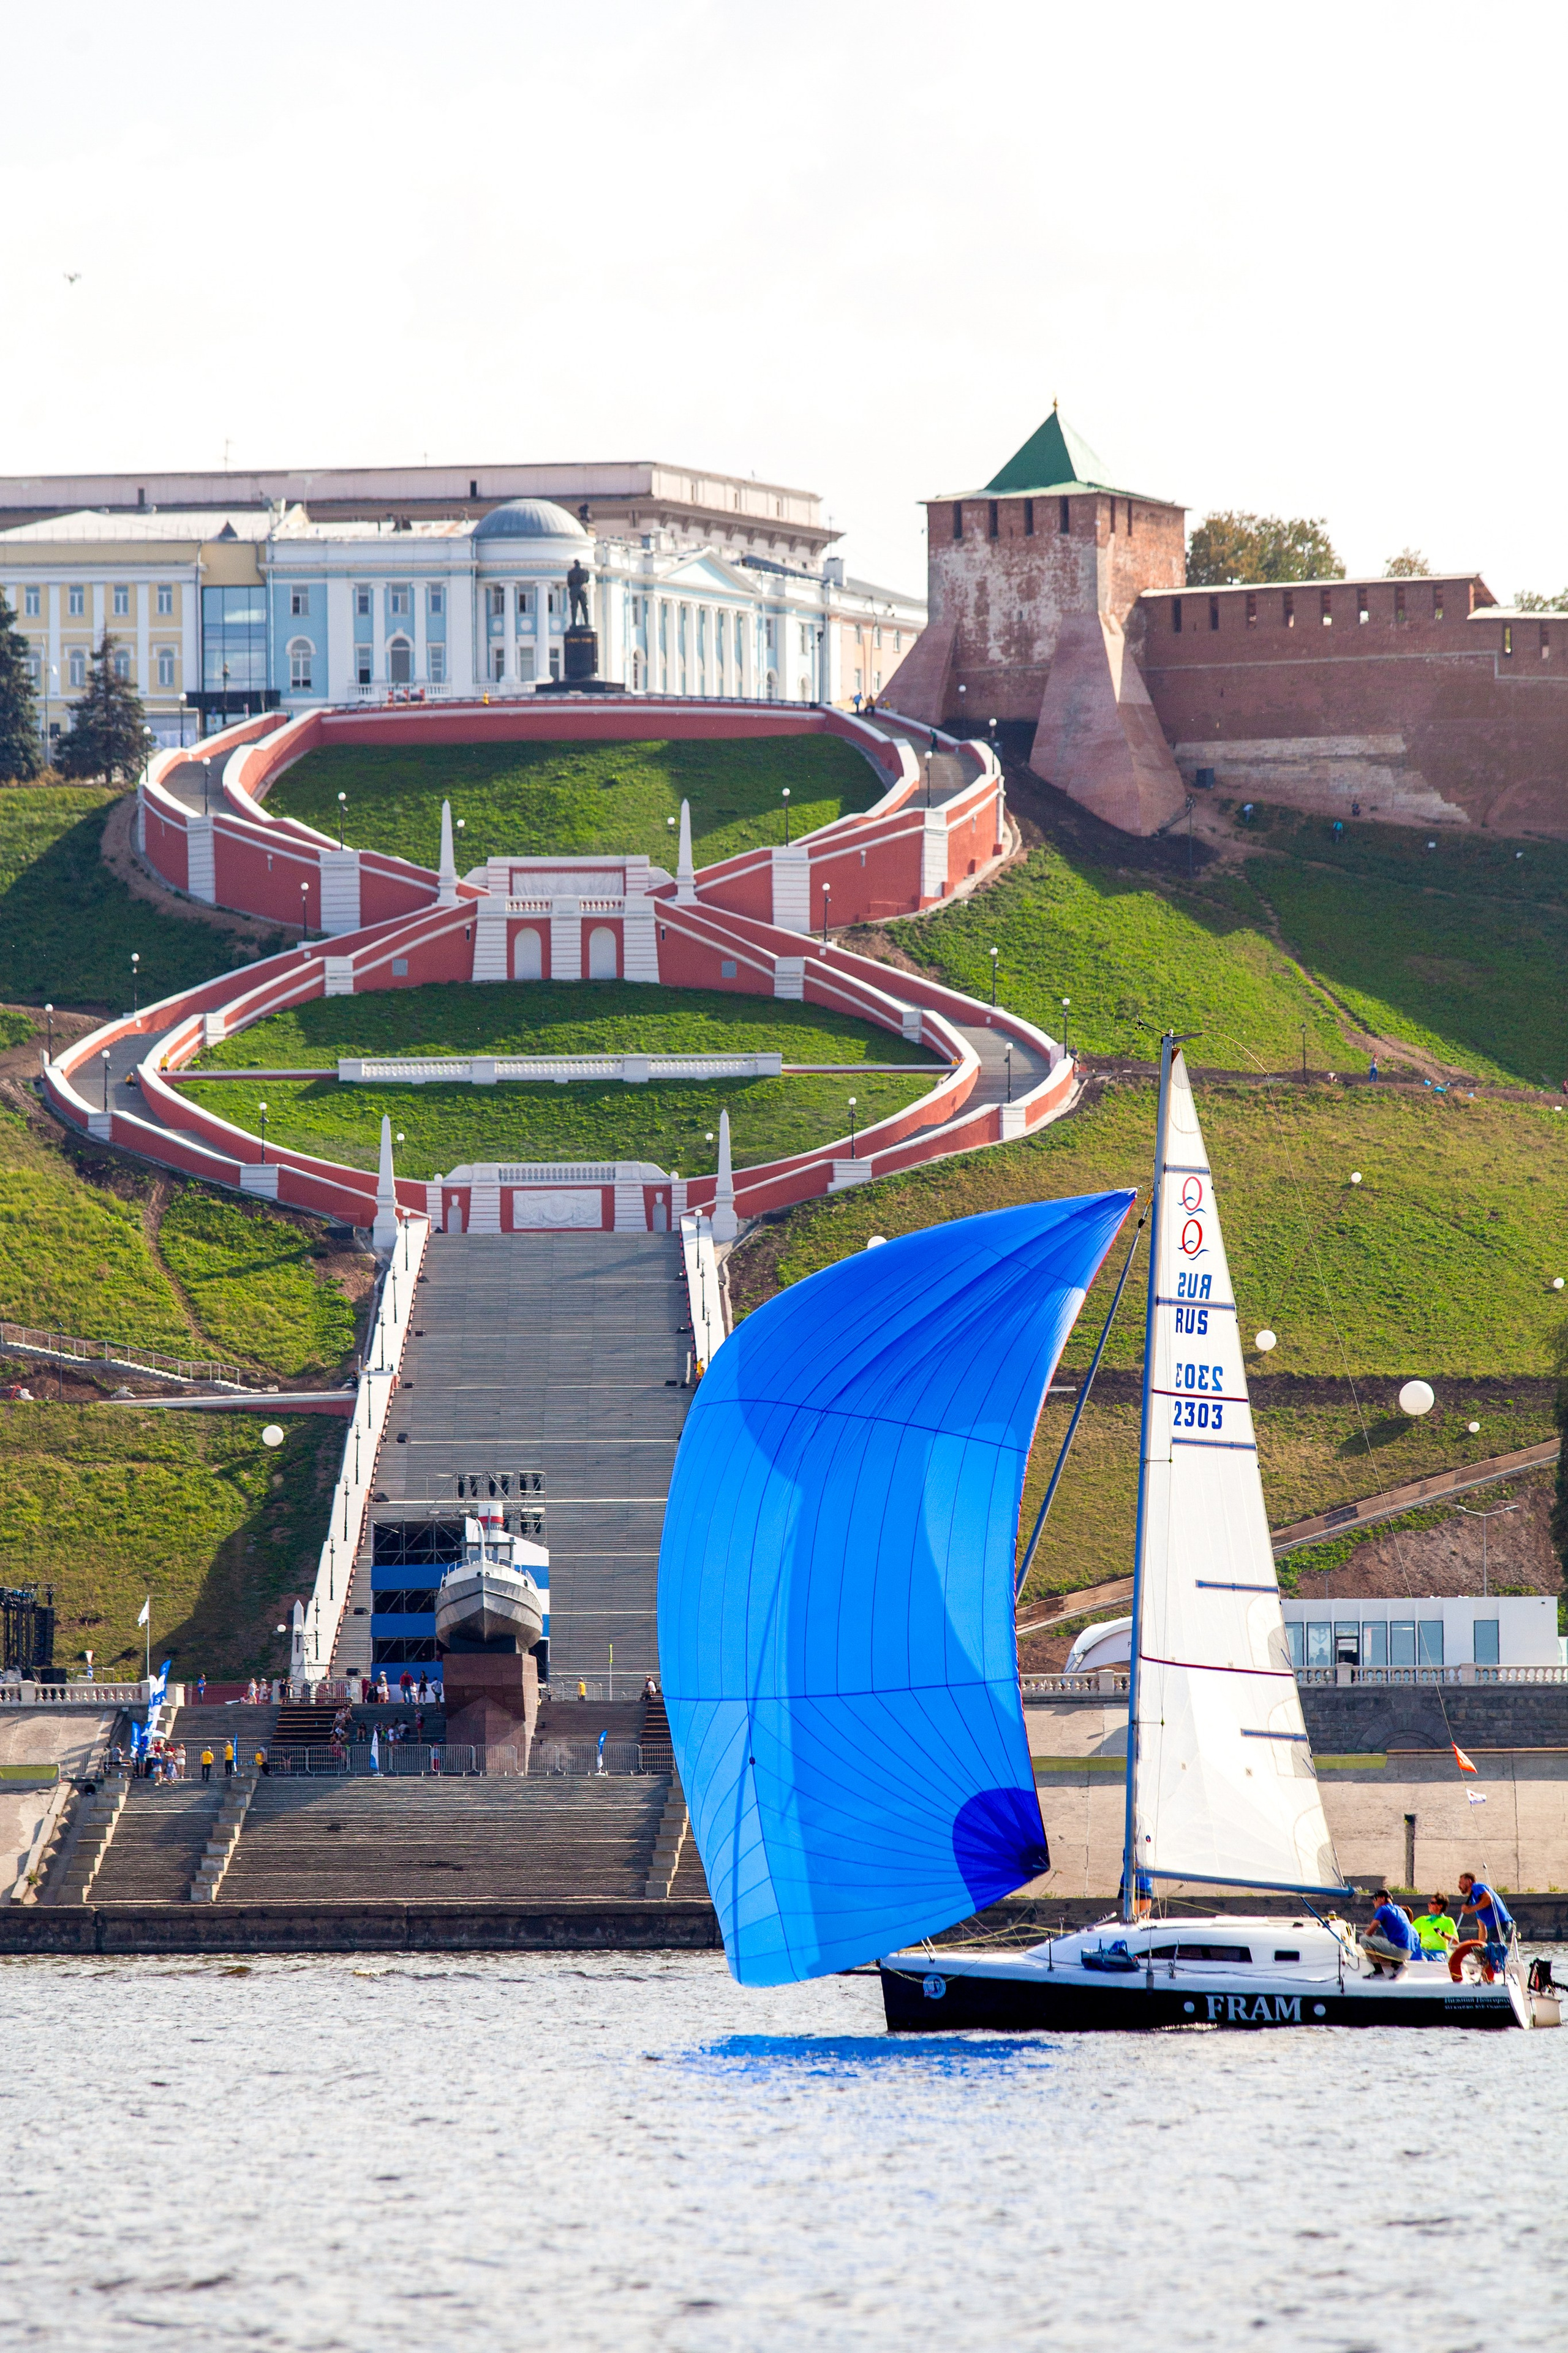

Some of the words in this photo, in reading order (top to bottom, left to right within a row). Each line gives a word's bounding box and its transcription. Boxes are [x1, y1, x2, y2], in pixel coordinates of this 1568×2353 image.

[1175, 1307, 1208, 1335] RUS
[1174, 1400, 1223, 1429] 2303
[1205, 1995, 1303, 2022] FRAM
